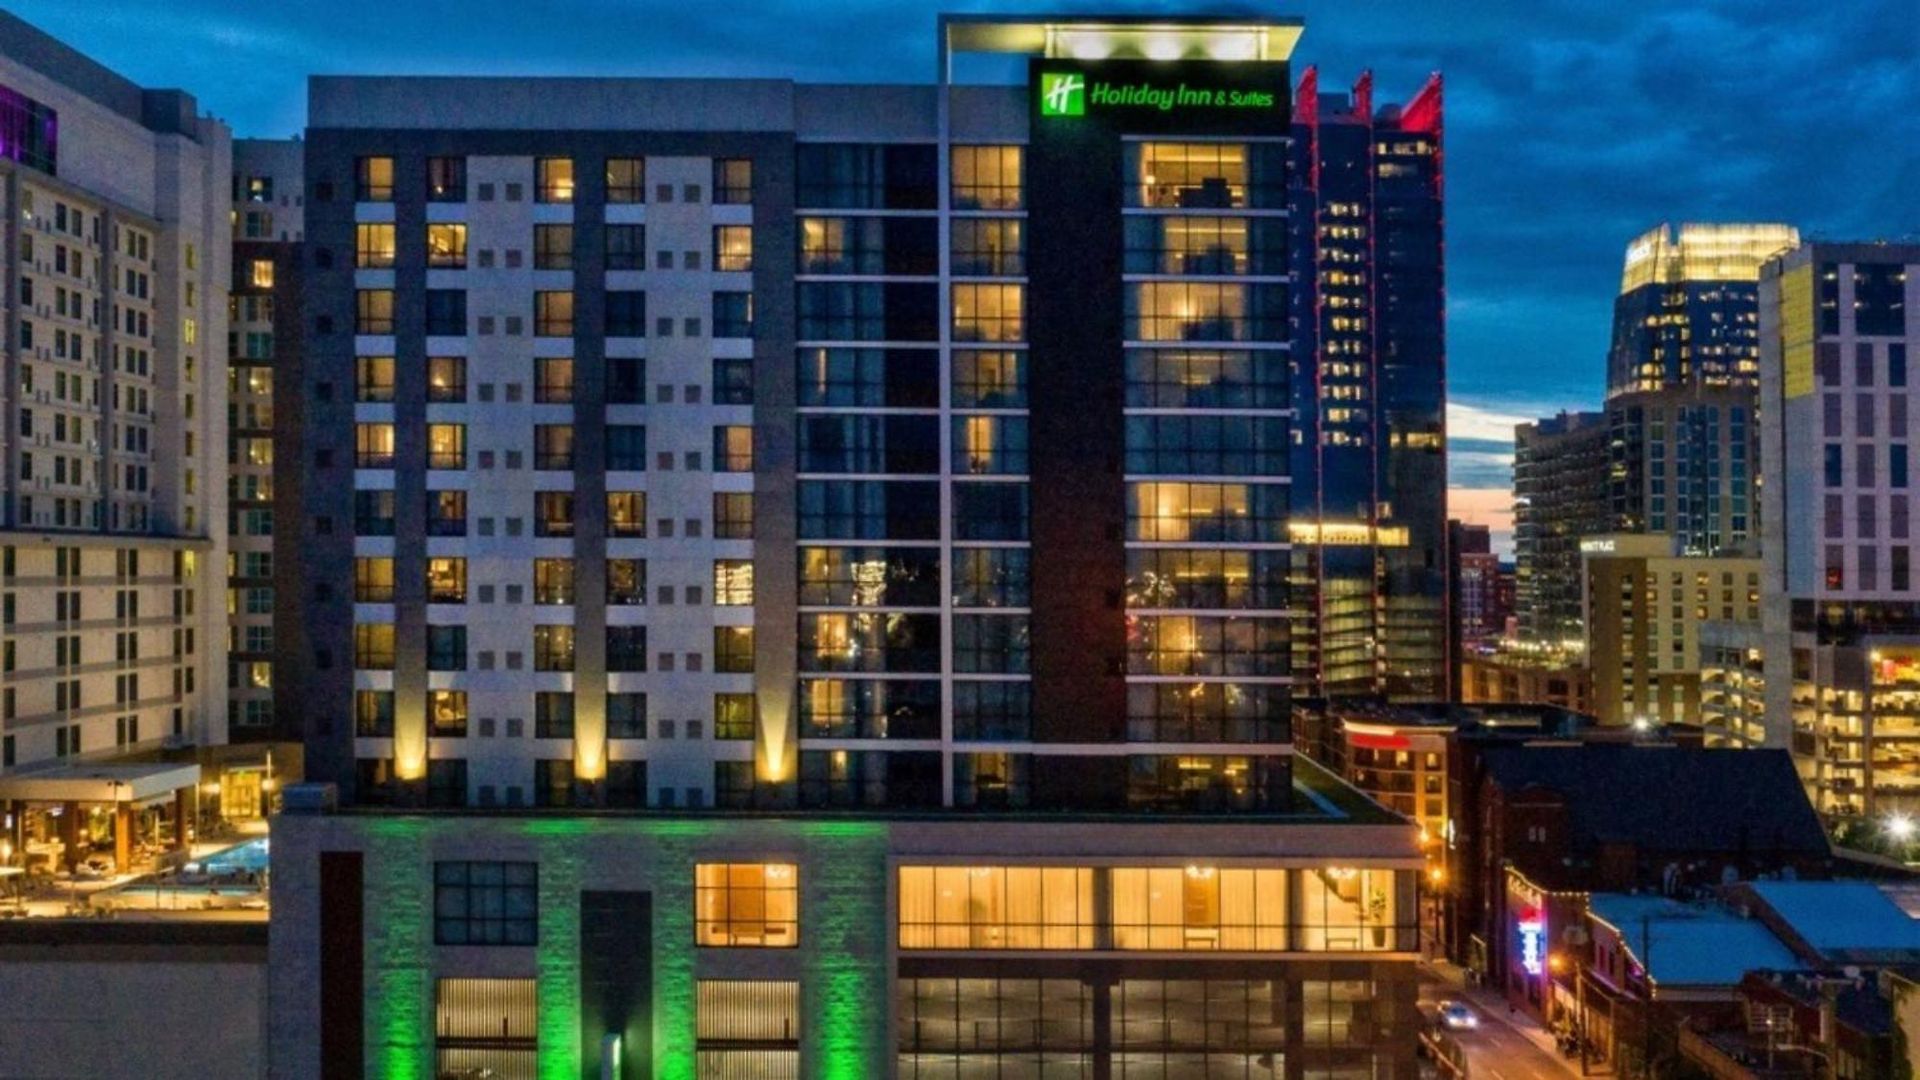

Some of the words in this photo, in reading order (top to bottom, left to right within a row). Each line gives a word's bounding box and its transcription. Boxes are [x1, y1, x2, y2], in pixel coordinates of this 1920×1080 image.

[1091, 83, 1174, 109] Holiday
[1178, 83, 1210, 105] Inn
[1214, 91, 1226, 106] &
[1229, 91, 1273, 107] Suites
